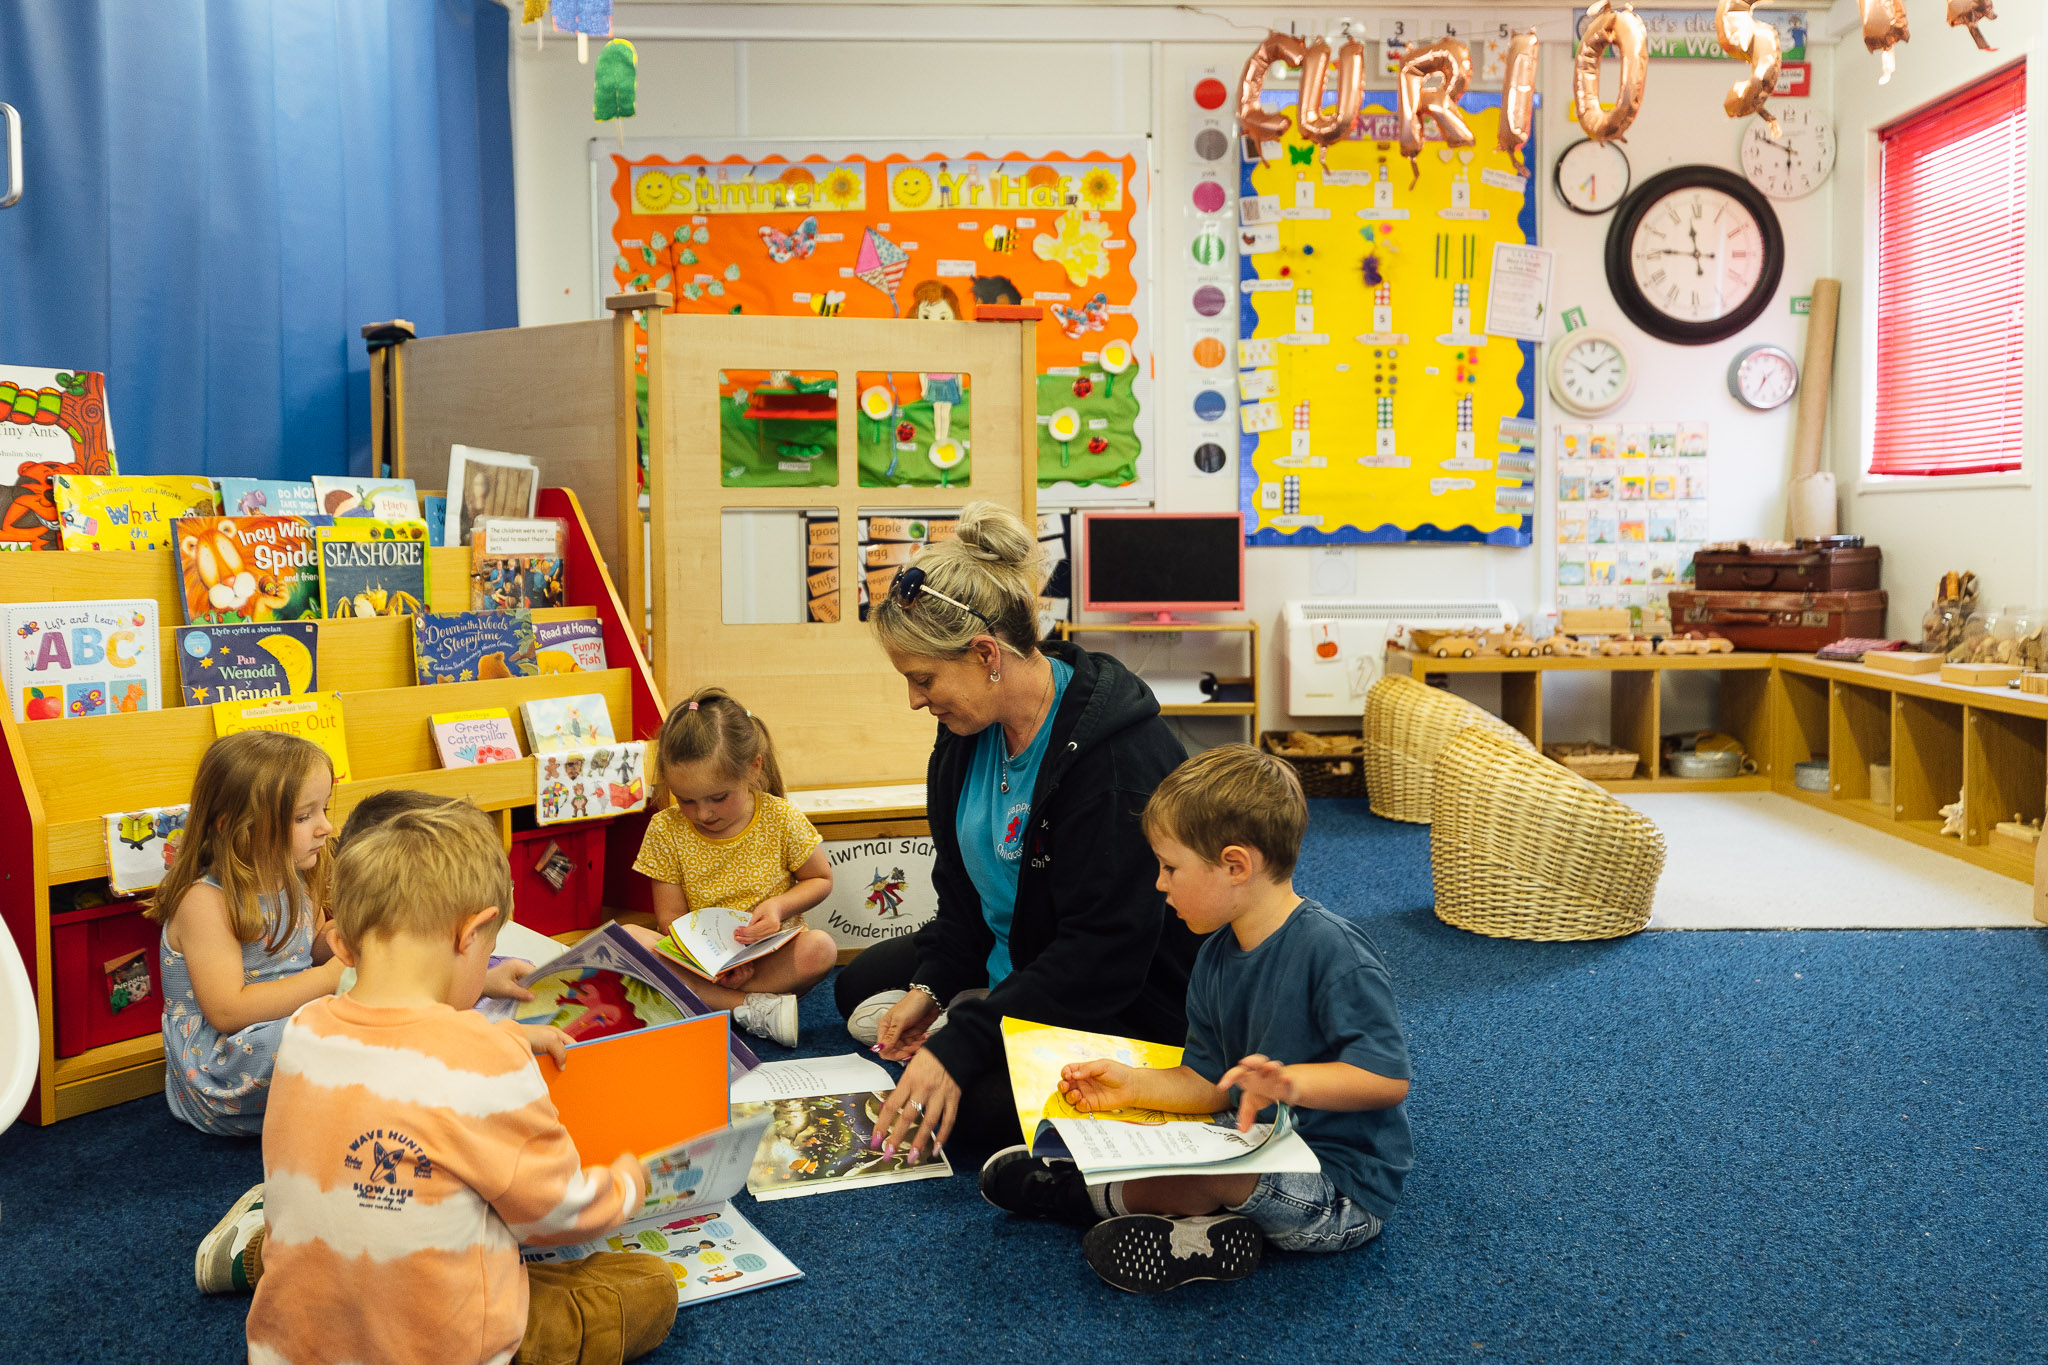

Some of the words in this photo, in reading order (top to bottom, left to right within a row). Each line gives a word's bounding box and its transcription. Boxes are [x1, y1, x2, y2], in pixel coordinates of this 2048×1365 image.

[1289, 20, 1296, 35] 1
[1341, 21, 1351, 36] 2
[1394, 20, 1405, 36] 3
[1446, 22, 1457, 36] 4
[1498, 23, 1509, 38] 5
[1648, 14, 1677, 33] at's
[1685, 13, 1716, 33] the
[1648, 36, 1677, 57] Mr
[1357, 118, 1400, 137] Mat
[670, 172, 826, 205] Summer
[942, 173, 984, 206] Yr
[1000, 175, 1072, 206] Haf
[28, 424, 59, 439] Ants
[277, 488, 291, 499] DO
[1265, 490, 1276, 500] 10
[280, 500, 297, 508] TAKE
[105, 499, 161, 526] What
[130, 526, 149, 539] the
[501, 527, 522, 535] children
[810, 525, 838, 538] spoo
[871, 522, 902, 533] apple
[237, 526, 277, 546] Incy
[255, 542, 318, 576] Spide
[325, 542, 422, 567] SEASHORE
[810, 548, 833, 563] fork
[868, 550, 888, 560] egg
[284, 572, 299, 582] and
[301, 571, 318, 582] frien
[809, 575, 837, 591] knife
[819, 603, 838, 622] pine
[44, 619, 66, 630] Lift
[70, 612, 89, 623] and
[425, 624, 459, 646] Down
[460, 622, 467, 631] in
[467, 619, 479, 630] the
[478, 616, 508, 631] Woods
[540, 625, 561, 641] Read
[561, 625, 571, 635] at
[571, 622, 597, 634] Home
[35, 627, 137, 671] ABC
[436, 642, 443, 652] at
[441, 630, 503, 660] Sleepytime
[572, 641, 602, 656] Funny
[236, 654, 256, 666] Pan
[578, 653, 601, 666] Fish
[218, 664, 277, 680] Wenodd
[245, 680, 252, 688] y
[216, 682, 282, 703] Lleuad
[306, 713, 336, 730] Out
[455, 721, 499, 734] Greedy
[448, 730, 508, 746] Caterpillar
[828, 836, 891, 868] iwrnai
[349, 1129, 383, 1152] WAVE
[354, 1182, 385, 1194] SLOW
[390, 1188, 414, 1197] LIFE
